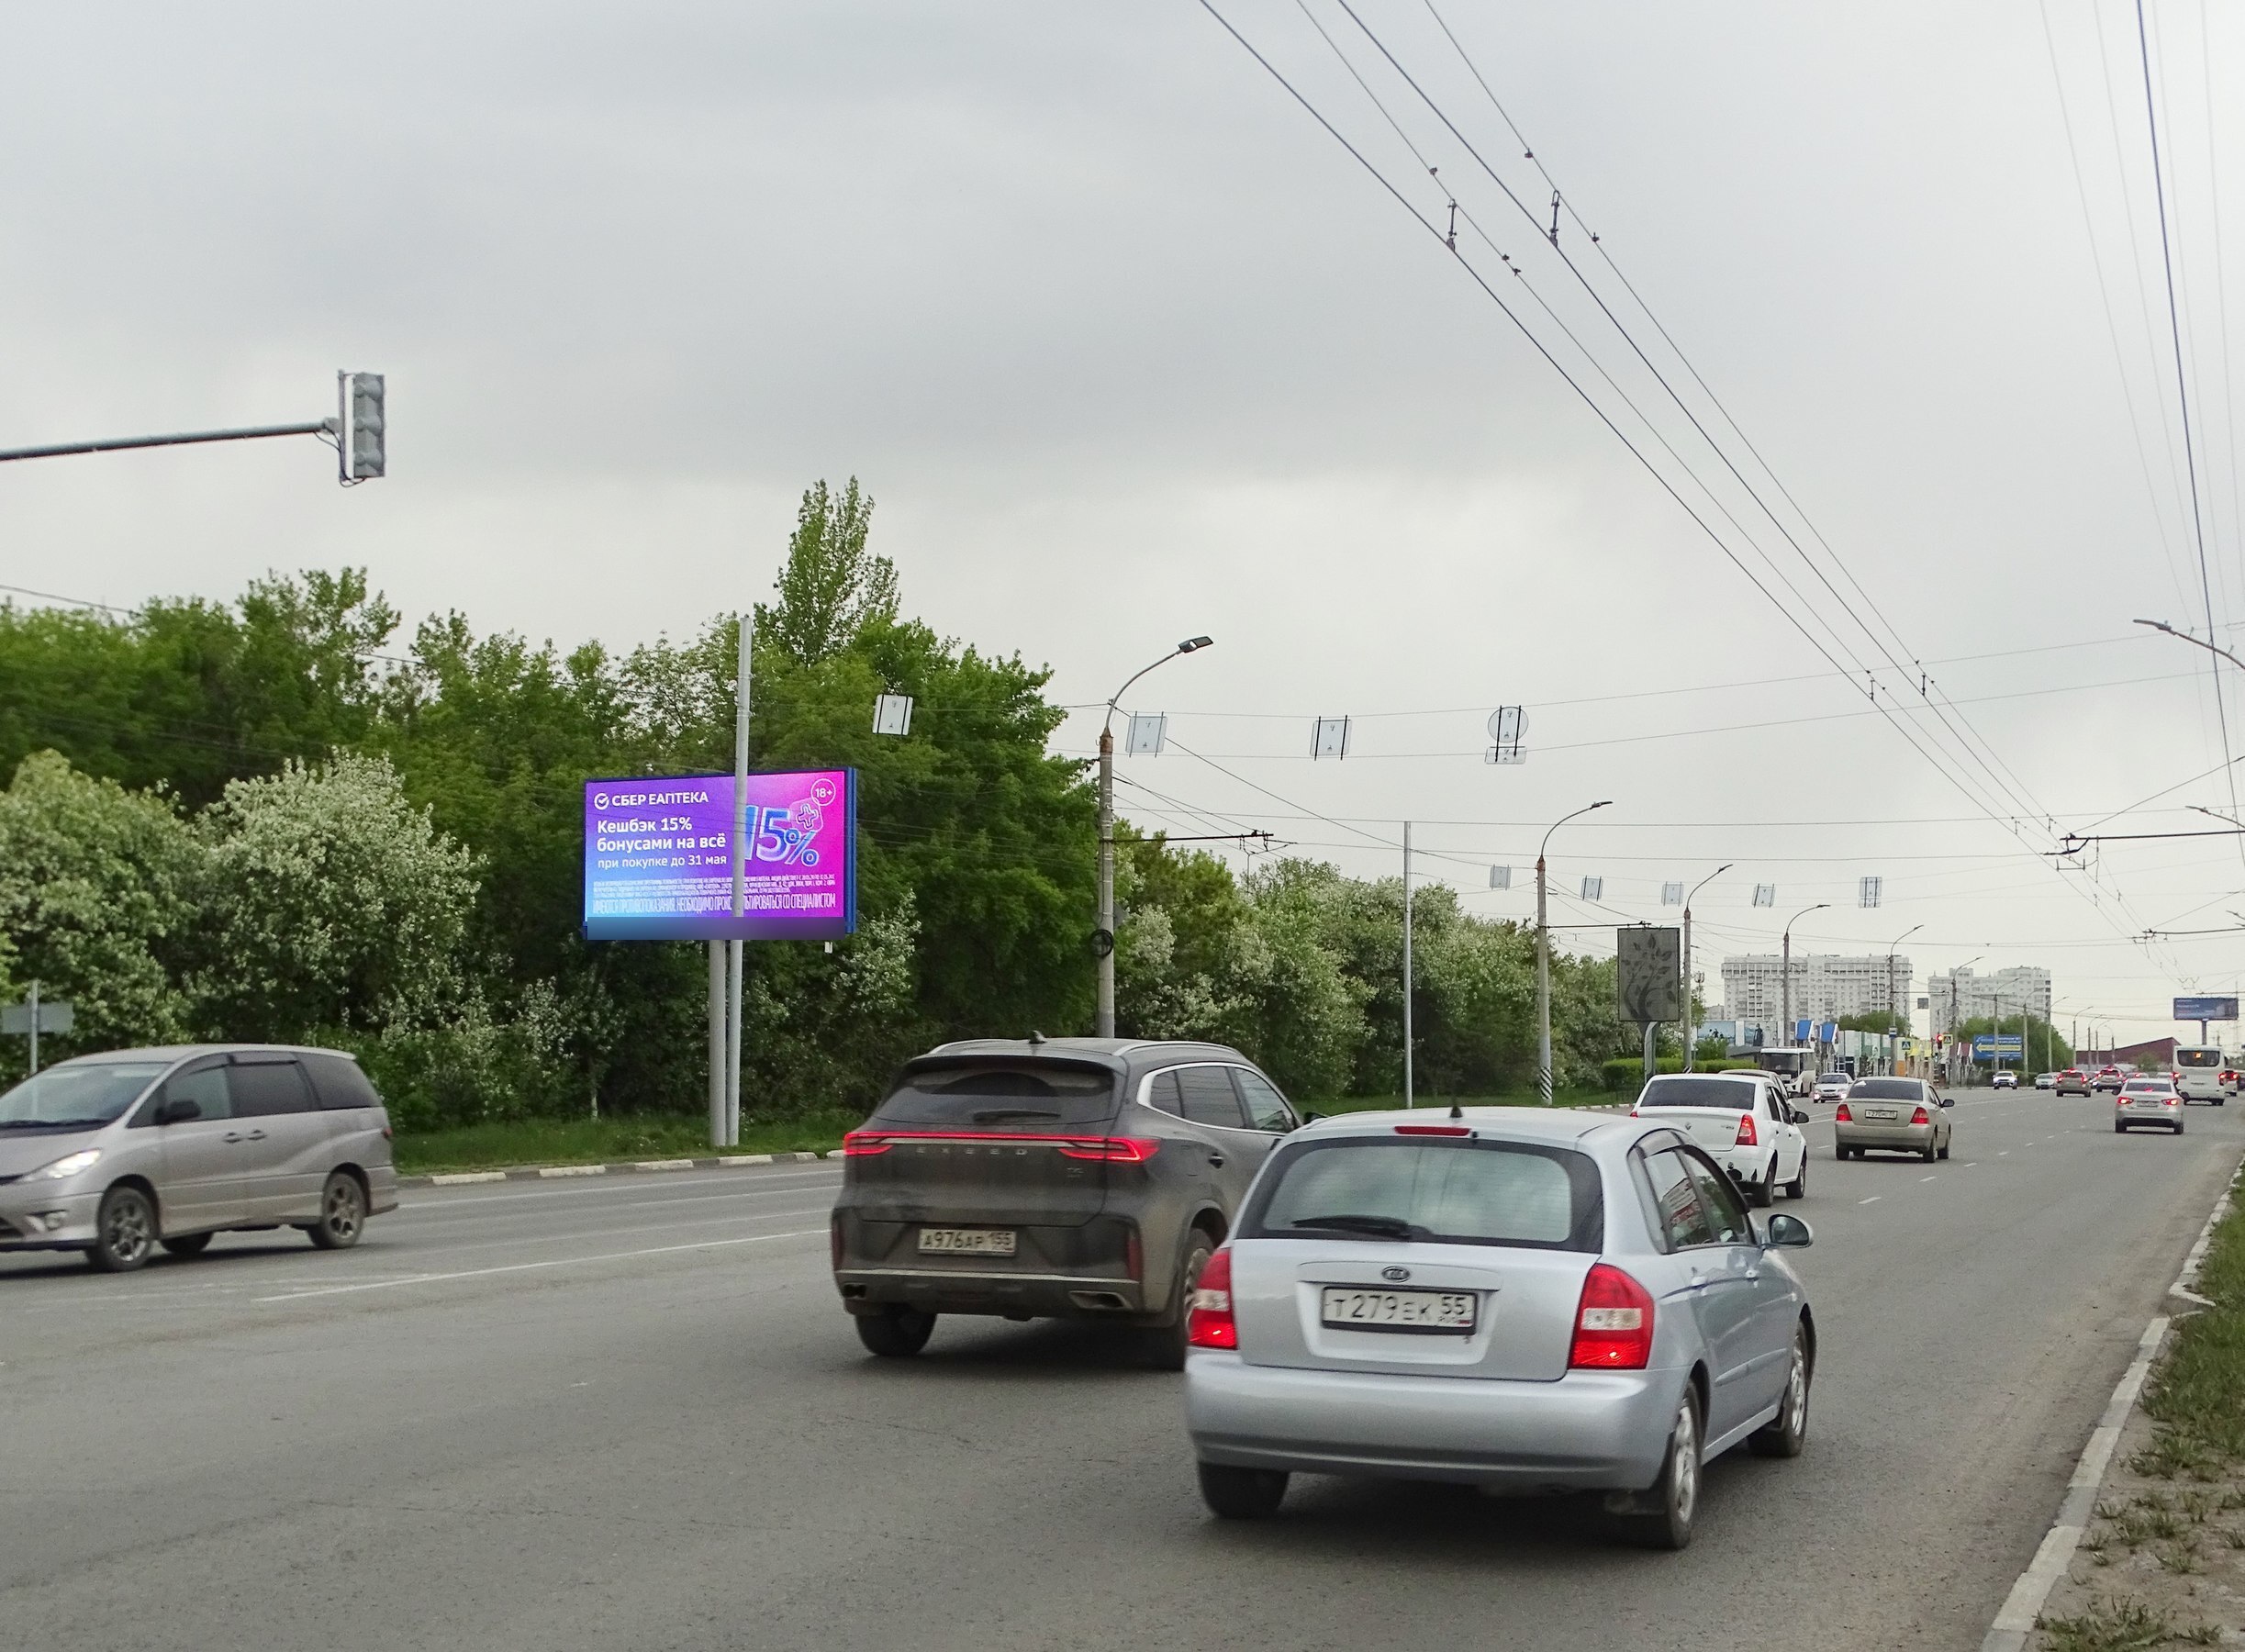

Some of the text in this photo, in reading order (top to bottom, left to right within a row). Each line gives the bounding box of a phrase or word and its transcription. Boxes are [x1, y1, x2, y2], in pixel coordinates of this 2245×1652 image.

[611, 791, 709, 807] СБЕР ЕАПТЕКА
[815, 787, 833, 798] 18+
[598, 817, 693, 833] Кешбэк 15%
[597, 833, 726, 854] бонусами на всё
[598, 854, 727, 870] при покупке до 31 мая
[1441, 1295, 1467, 1315] 55
